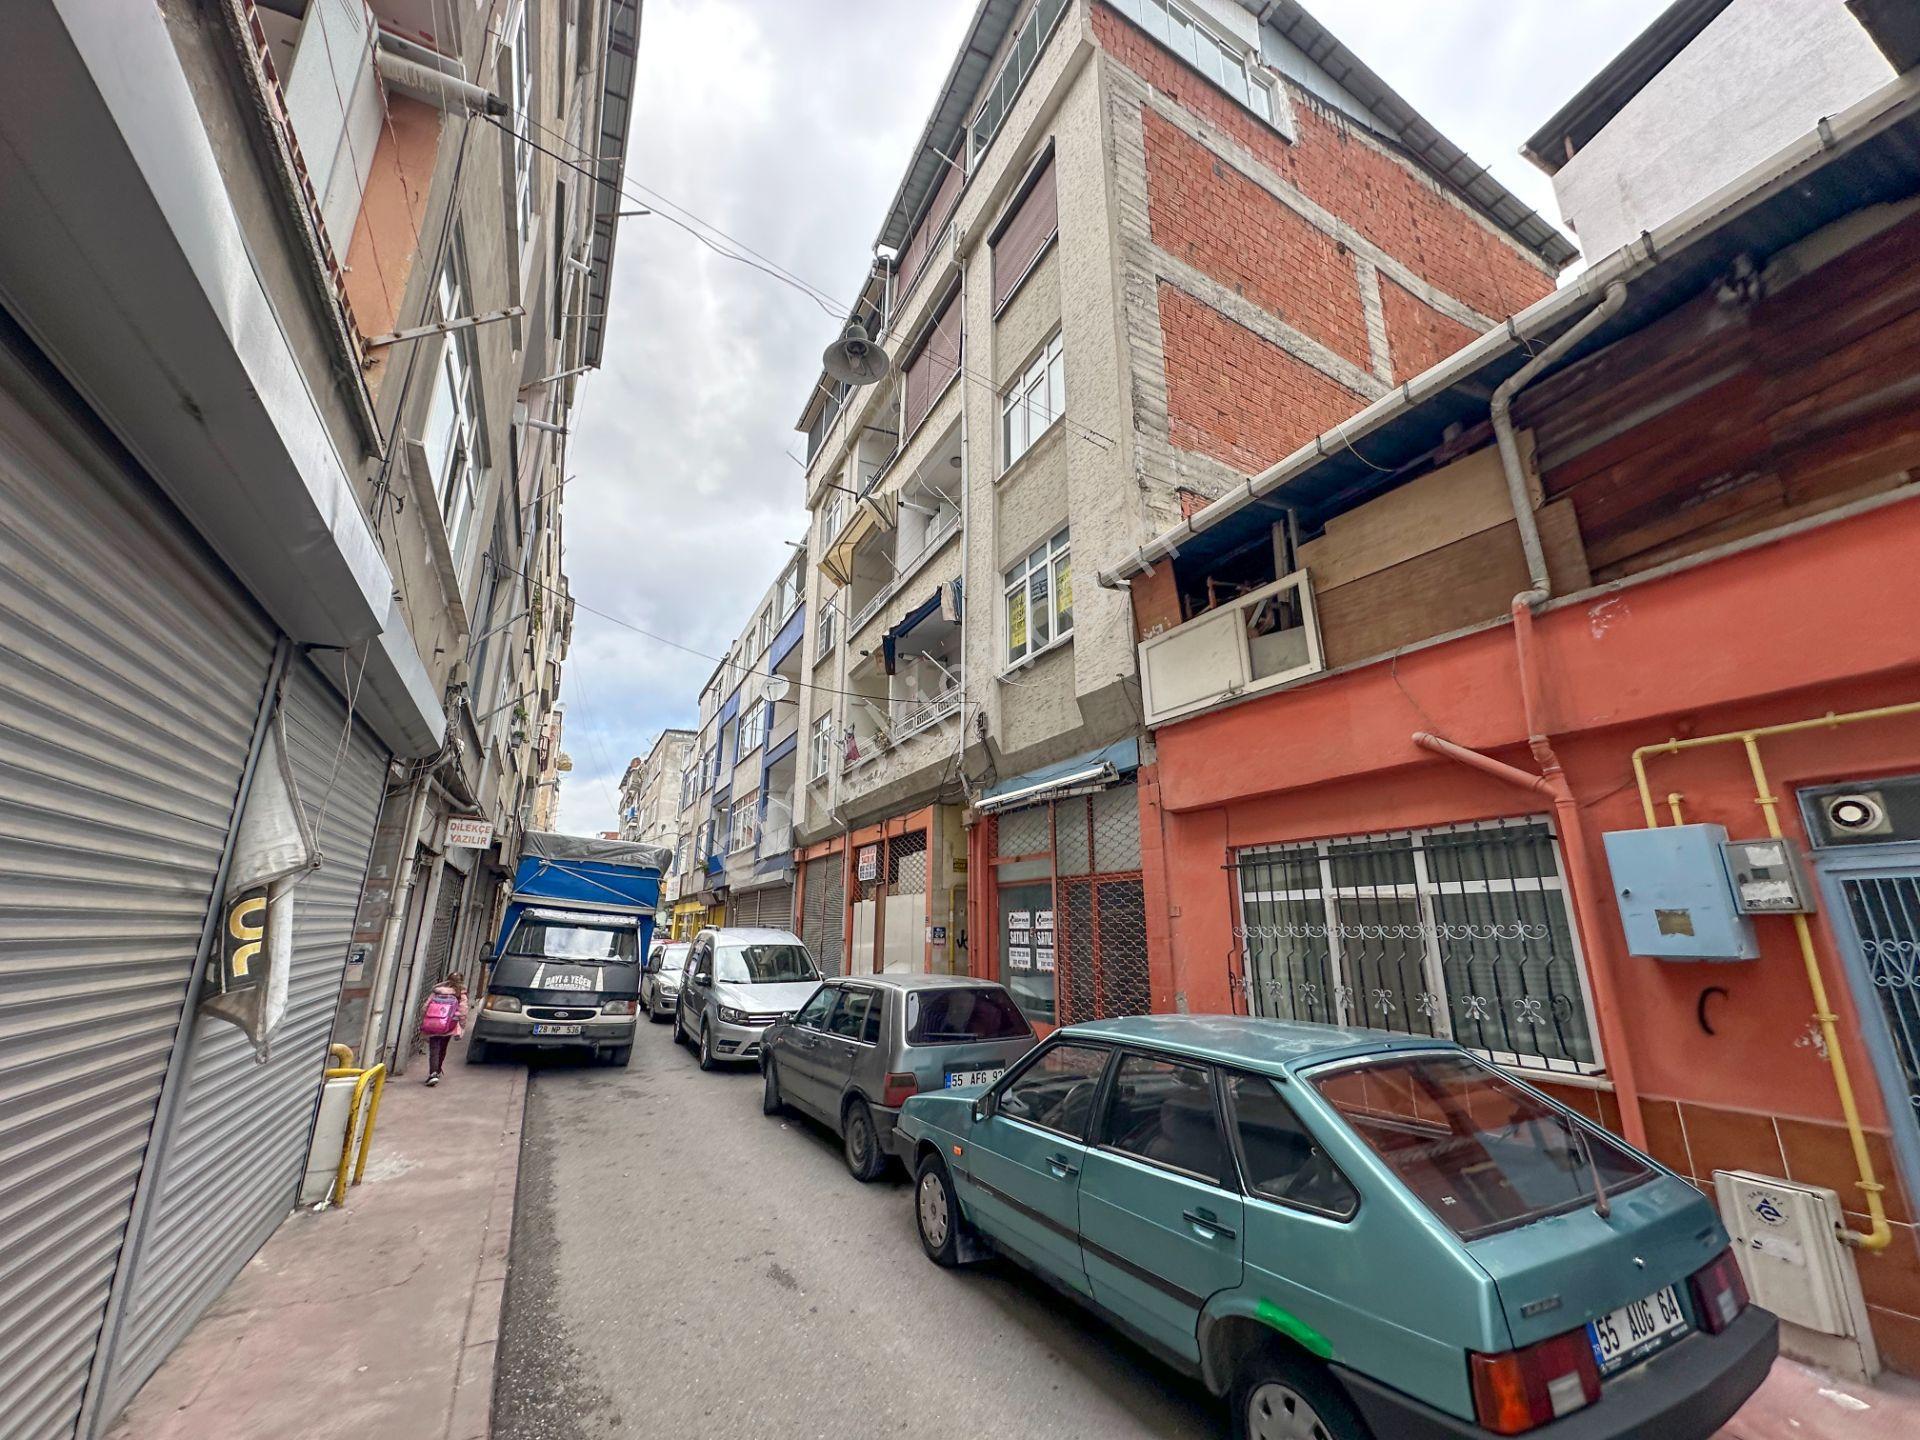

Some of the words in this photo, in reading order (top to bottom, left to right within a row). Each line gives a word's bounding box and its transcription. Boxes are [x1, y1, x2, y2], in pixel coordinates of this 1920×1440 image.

[450, 822, 491, 834] DİLEKÇE
[450, 834, 487, 845] YAZILIR
[539, 1025, 548, 1034] 28
[551, 1026, 561, 1034] NP
[952, 1074, 963, 1087] 55
[970, 1071, 987, 1085] AFG
[1597, 1315, 1620, 1354] 55
[1626, 1299, 1655, 1342] AUG
[1657, 1288, 1679, 1324] 64
